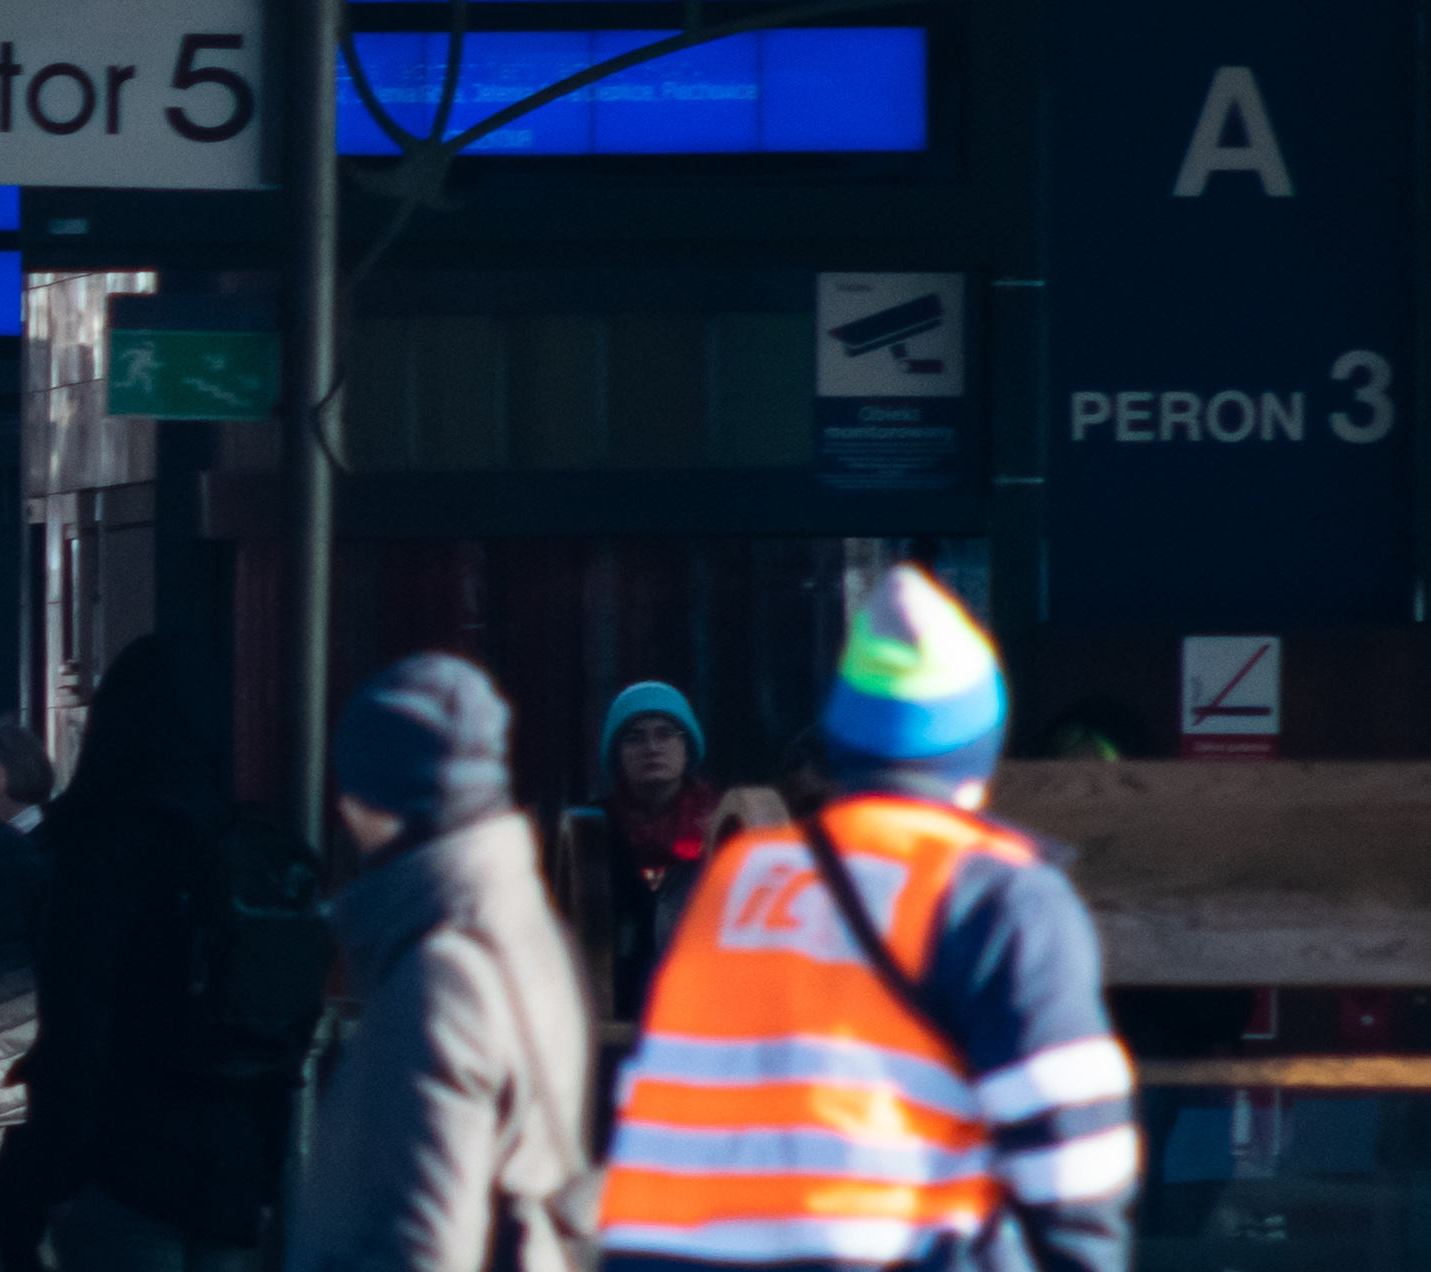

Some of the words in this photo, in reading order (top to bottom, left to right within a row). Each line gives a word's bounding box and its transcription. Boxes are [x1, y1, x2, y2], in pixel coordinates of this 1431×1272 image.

[164, 33, 254, 143] 5
[1172, 66, 1294, 197] A
[1070, 390, 1305, 443] PERON
[1329, 349, 1395, 444] 3
